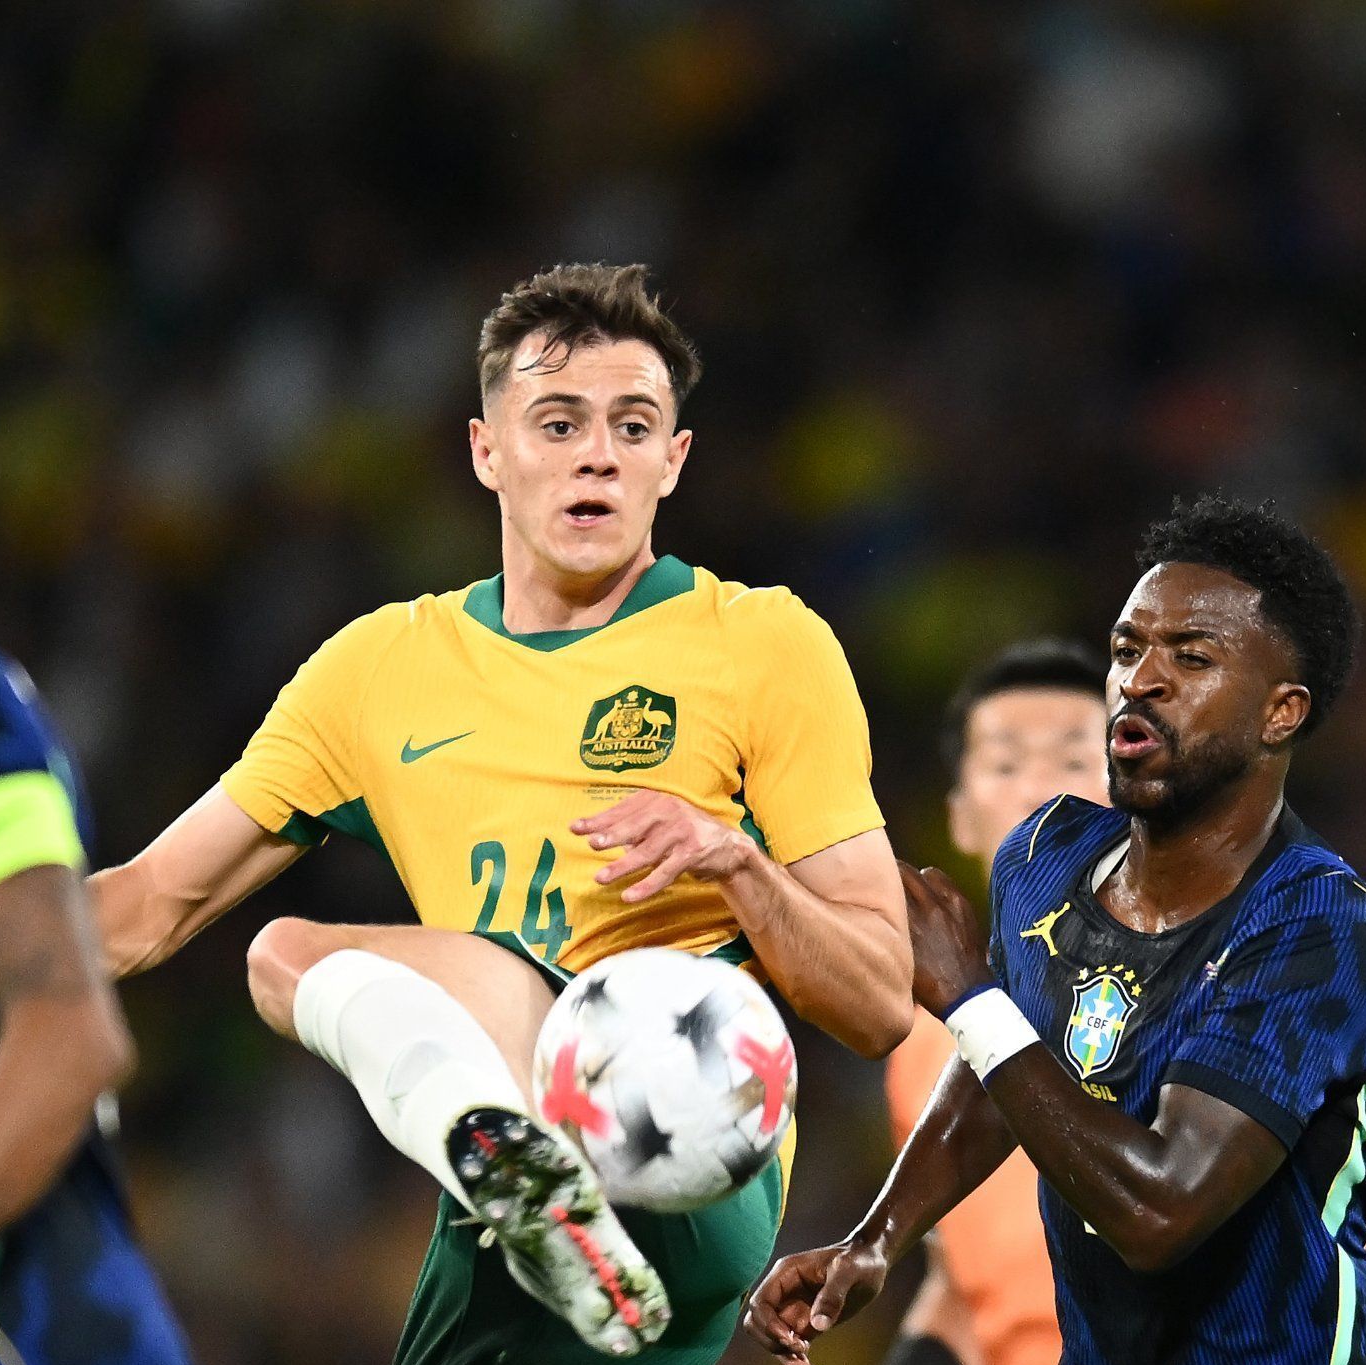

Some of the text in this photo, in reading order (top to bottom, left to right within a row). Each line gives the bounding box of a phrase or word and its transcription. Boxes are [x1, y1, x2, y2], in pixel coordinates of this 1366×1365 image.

[592, 739, 657, 752] AUSTRALIA
[470, 837, 573, 963] 24
[1087, 1016, 1109, 1030] CBF
